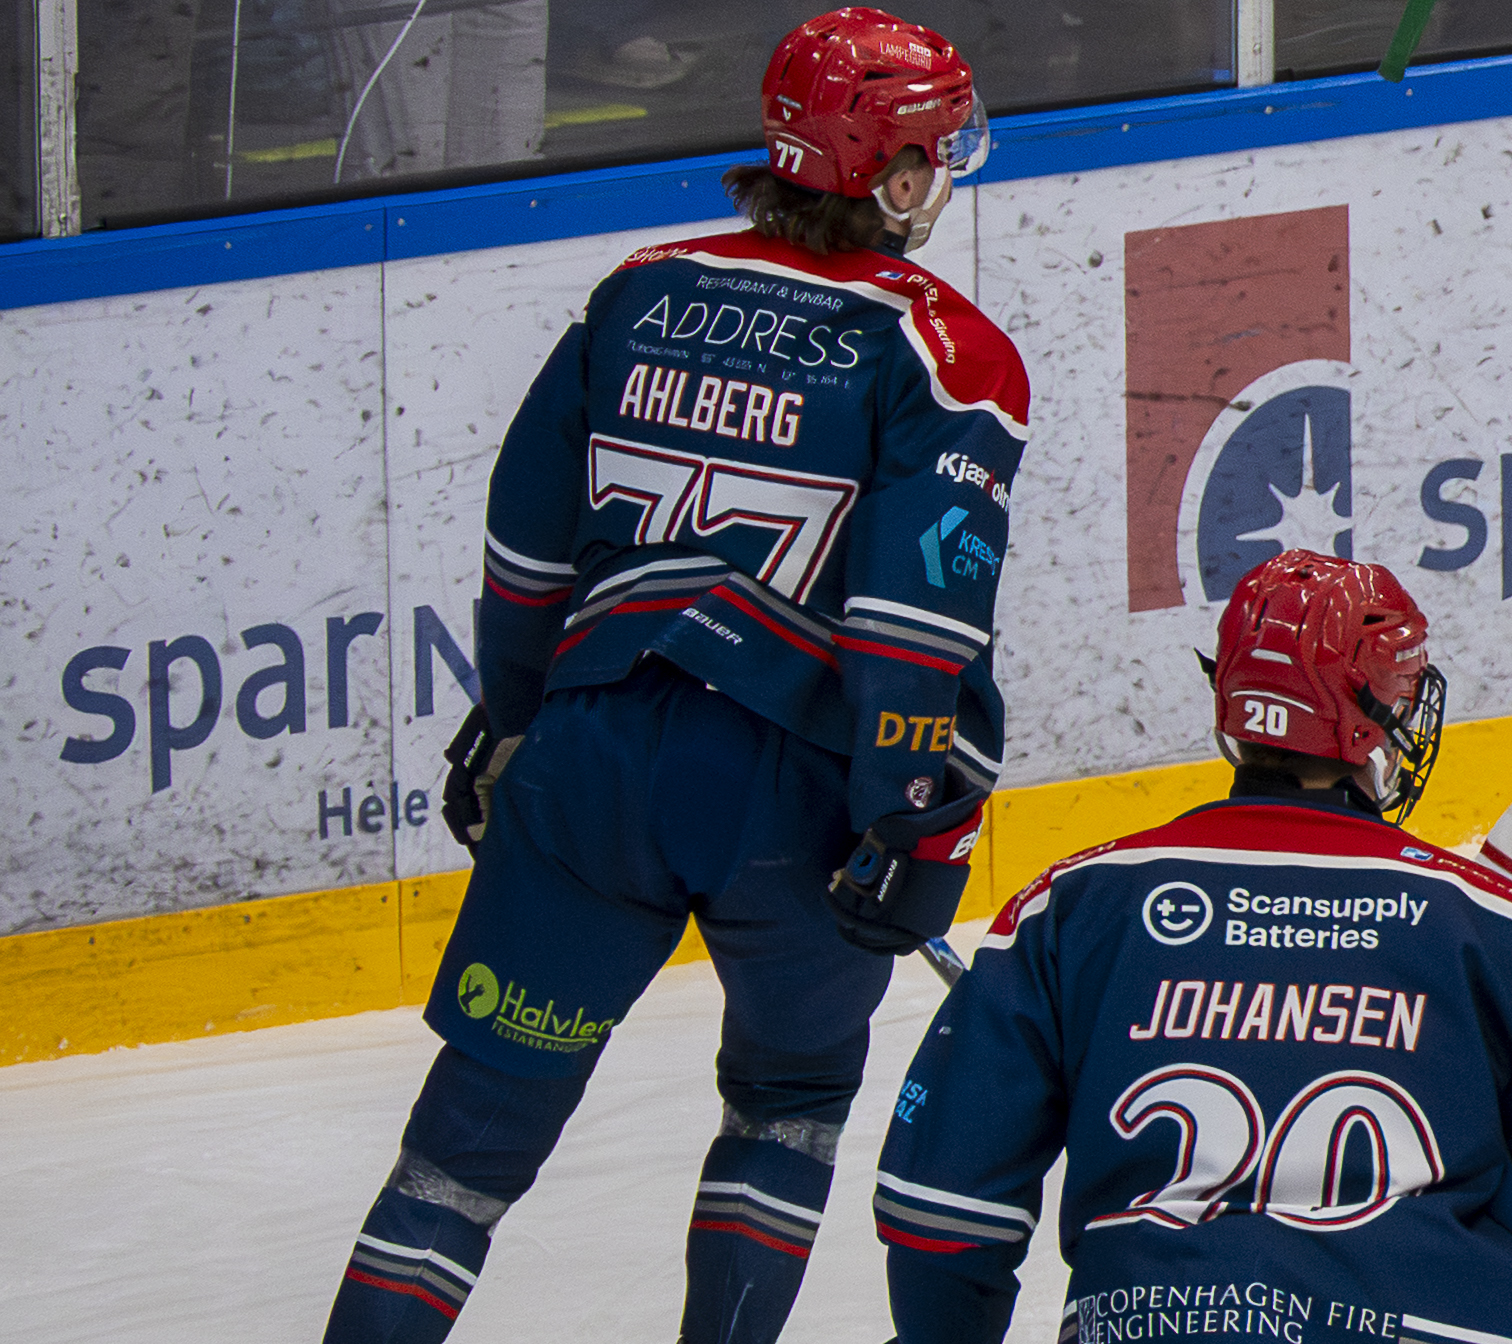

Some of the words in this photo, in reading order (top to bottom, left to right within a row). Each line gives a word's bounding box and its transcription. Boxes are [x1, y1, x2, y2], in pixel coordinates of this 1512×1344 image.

[775, 140, 804, 174] 77
[697, 275, 777, 295] RESTAURANT
[792, 289, 844, 313] VINBAR
[633, 294, 863, 369] ADDRESS
[619, 363, 804, 447] AHLBERG
[589, 433, 859, 606] 77
[951, 555, 980, 580] CM
[681, 606, 743, 646] BAUER
[60, 611, 384, 793] spar
[1244, 699, 1289, 737] 20
[318, 787, 428, 840] Hele
[1227, 887, 1428, 926] Scansupply
[1225, 920, 1379, 949] Batteries
[1129, 980, 1427, 1052] JOHANSEN
[1085, 1062, 1445, 1232] 20
[1096, 1283, 1313, 1320] COPENHAGEN
[1328, 1301, 1398, 1339] FIRE
